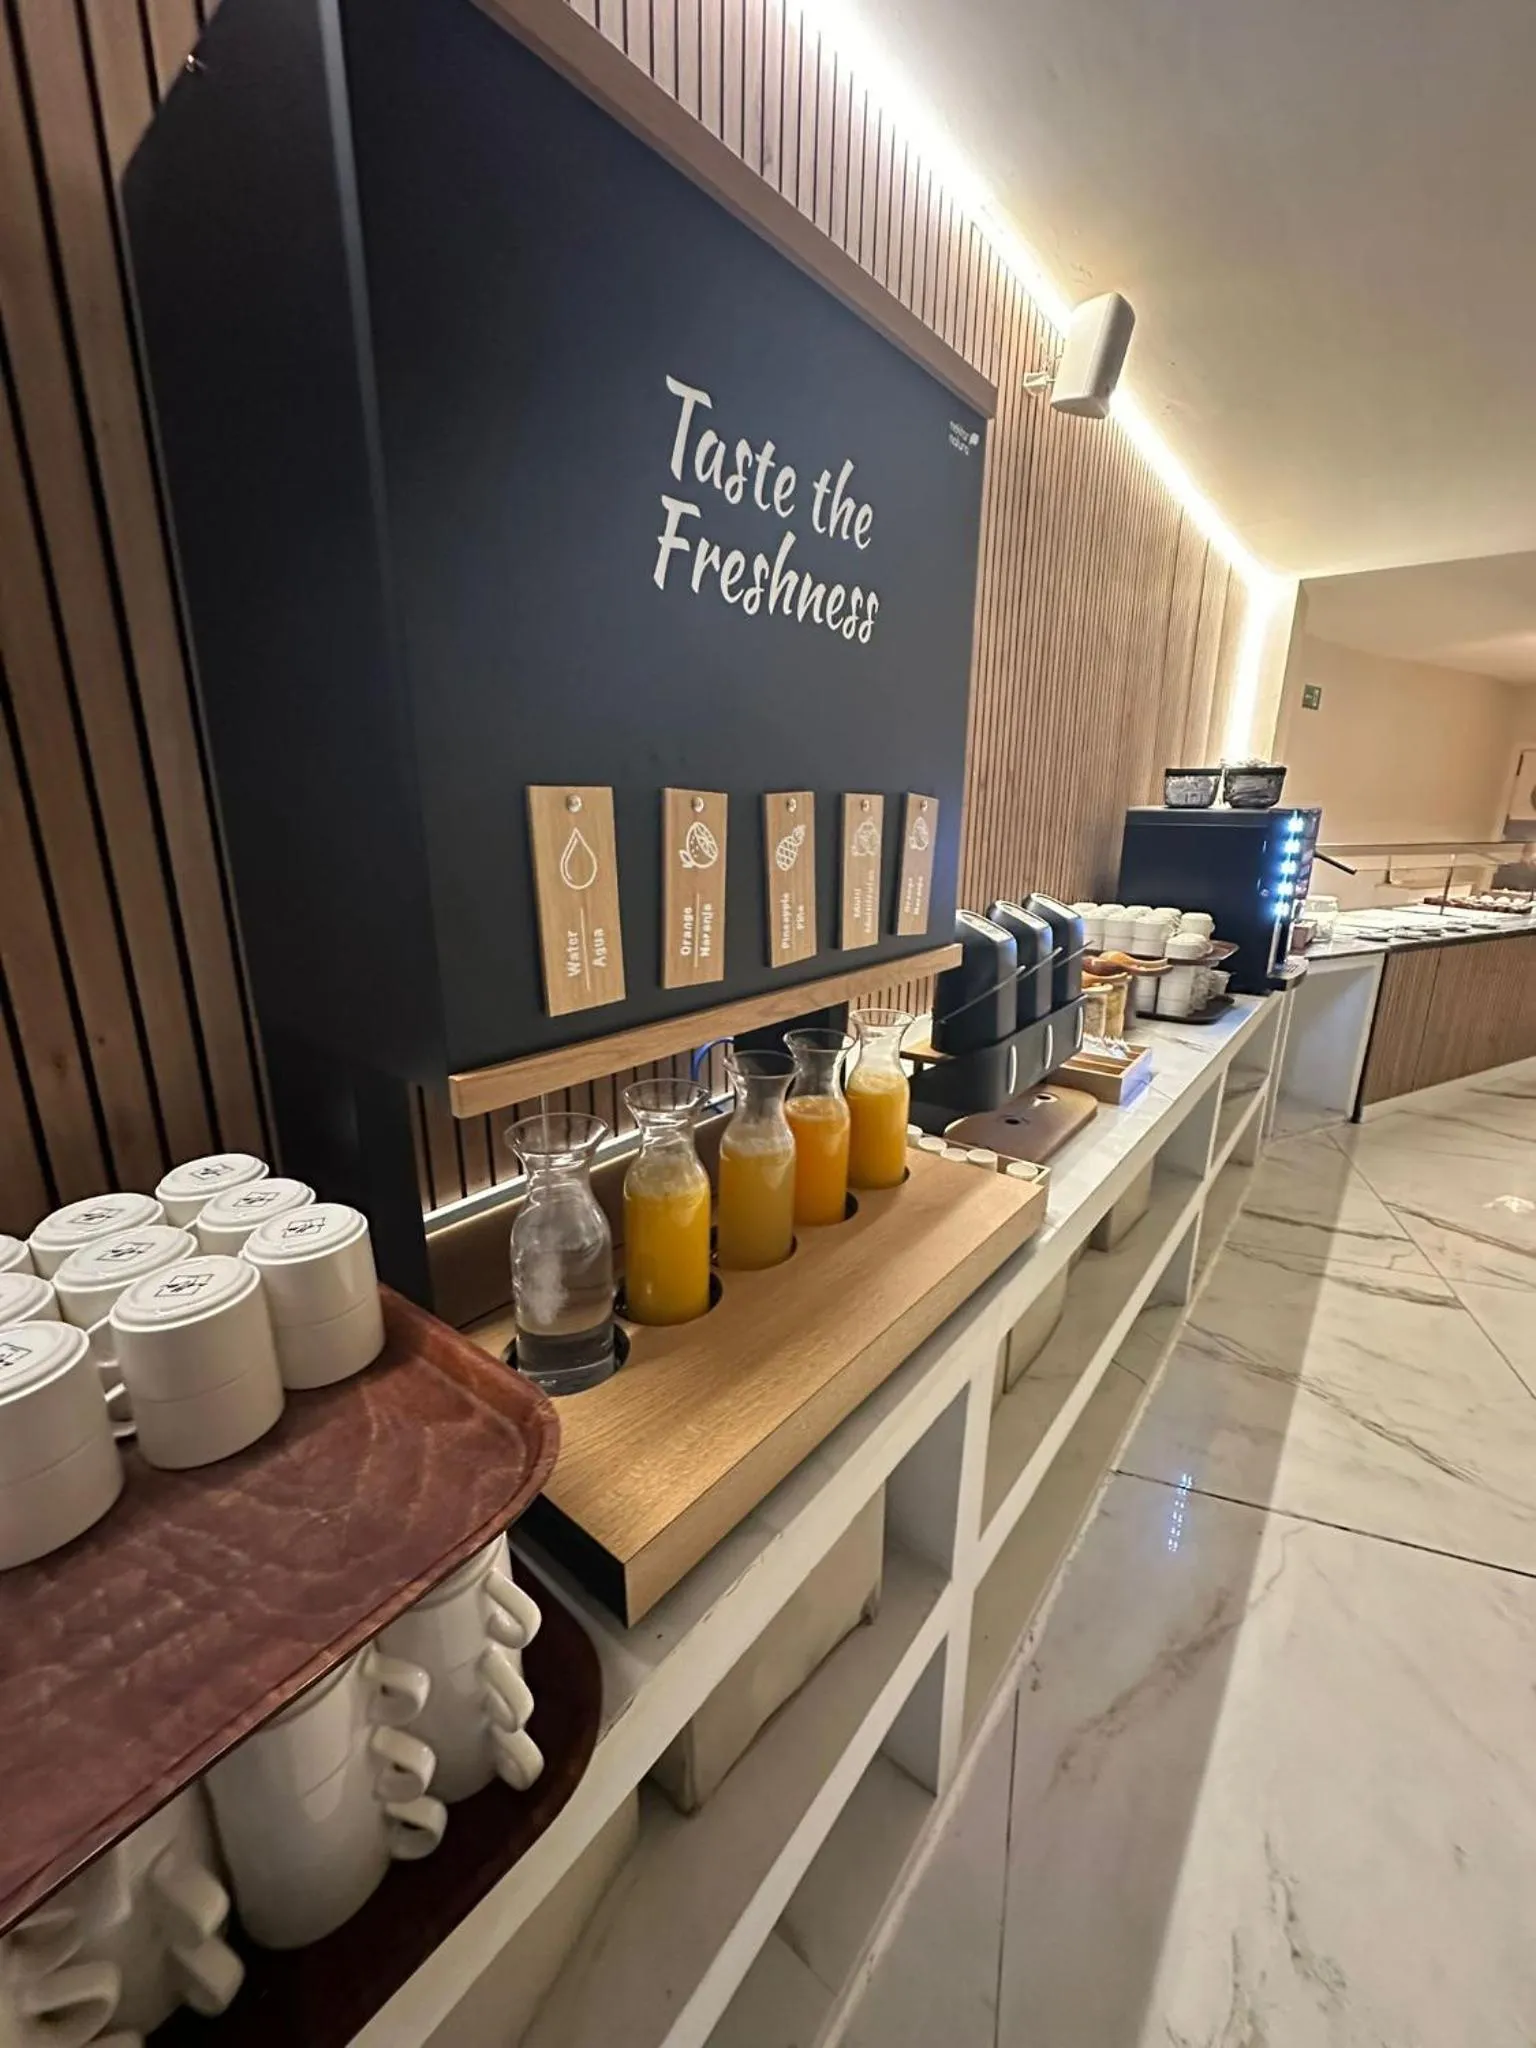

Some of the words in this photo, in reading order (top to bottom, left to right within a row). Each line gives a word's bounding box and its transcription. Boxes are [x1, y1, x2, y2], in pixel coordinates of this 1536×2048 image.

[666, 374, 796, 518] Taste
[812, 459, 873, 550] the
[653, 494, 880, 644] Freshness
[565, 930, 581, 978] Water
[591, 927, 607, 968] Agua
[679, 906, 694, 957] Orange
[699, 903, 715, 957] Naranja
